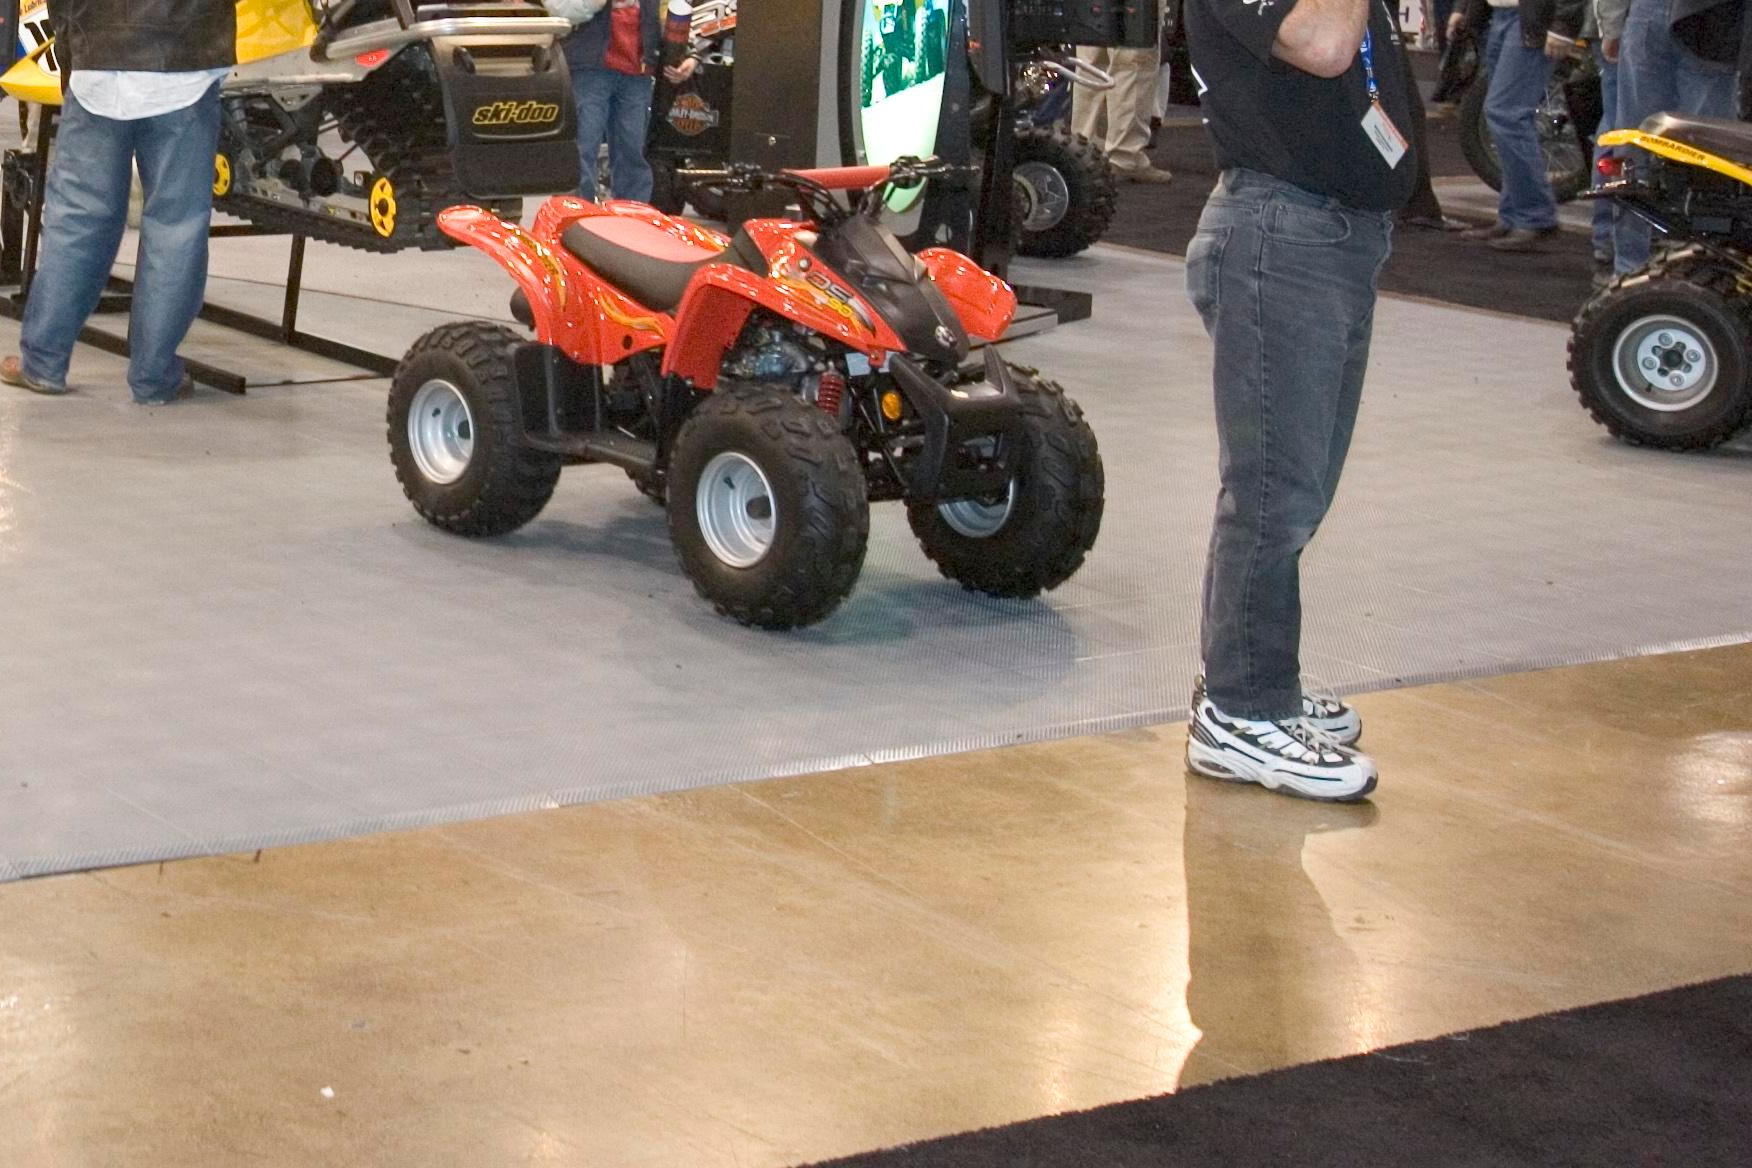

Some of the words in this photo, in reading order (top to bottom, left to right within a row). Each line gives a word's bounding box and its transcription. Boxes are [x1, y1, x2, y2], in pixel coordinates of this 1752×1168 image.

[472, 101, 559, 125] ski-doo
[1639, 135, 1707, 161] BOMBARDIER
[807, 271, 854, 305] DS
[827, 296, 853, 318] 90
